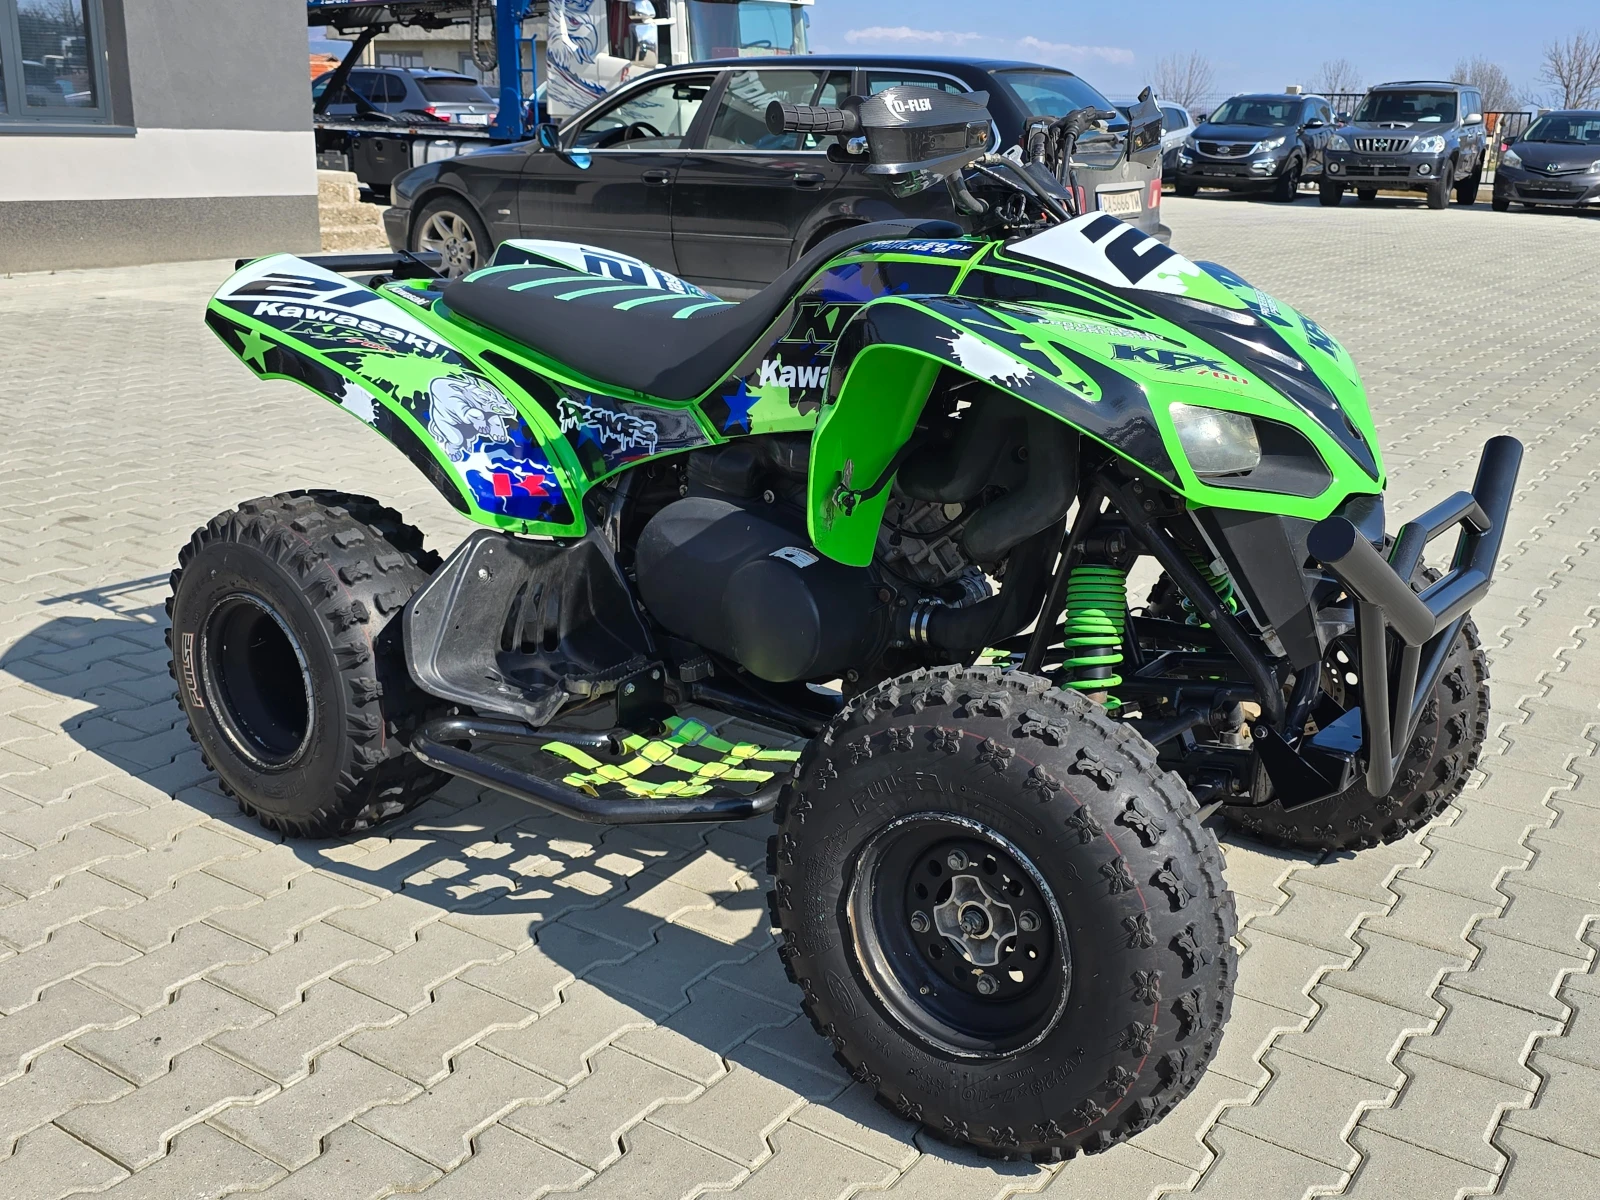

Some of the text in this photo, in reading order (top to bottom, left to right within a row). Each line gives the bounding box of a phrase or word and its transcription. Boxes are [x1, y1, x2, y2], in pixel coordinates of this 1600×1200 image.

[253, 302, 438, 353] Kawasaki
[1107, 342, 1237, 377] KFX
[1197, 370, 1249, 385] 700
[181, 632, 205, 708] PULSE
